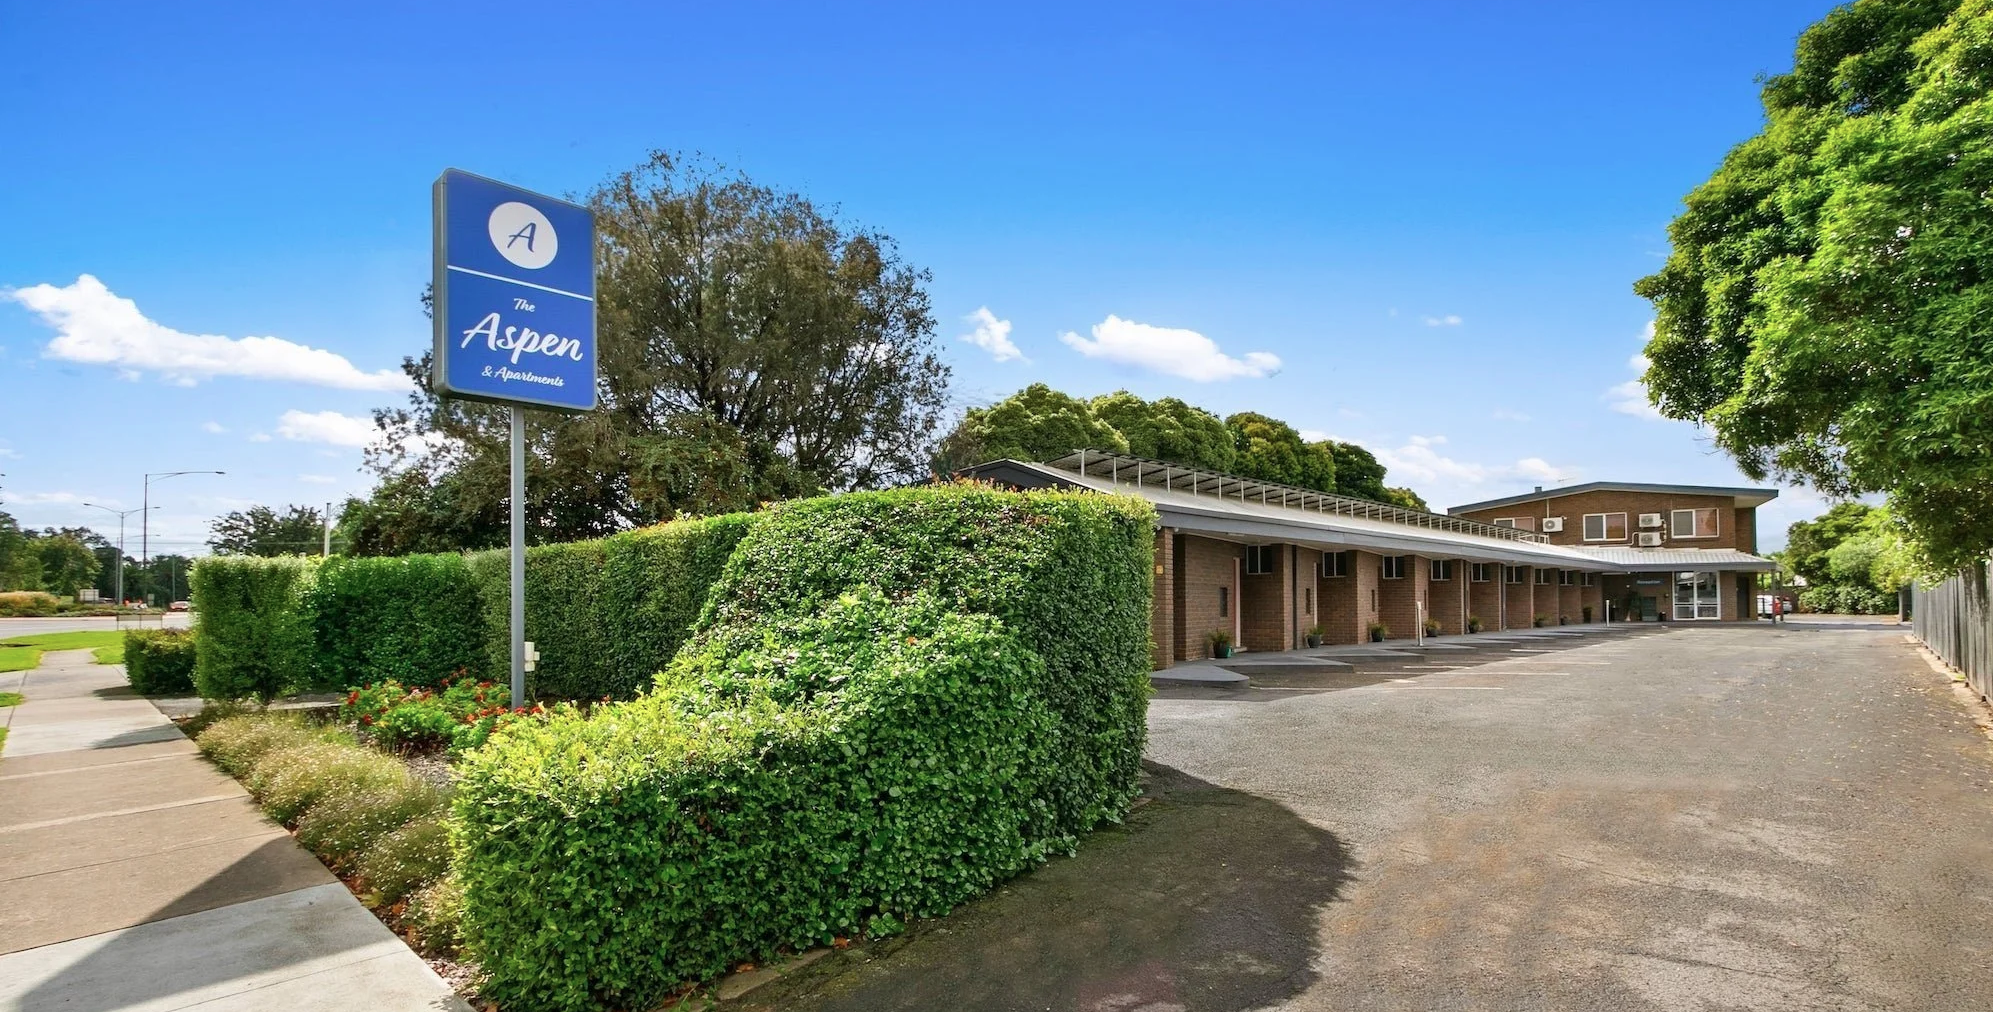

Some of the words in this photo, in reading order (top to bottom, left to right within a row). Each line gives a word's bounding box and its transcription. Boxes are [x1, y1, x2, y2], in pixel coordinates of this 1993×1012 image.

[507, 222, 536, 252] A
[513, 298, 535, 312] The
[461, 312, 583, 364] Aspen
[481, 366, 492, 377] &
[494, 366, 565, 387] Apartments
